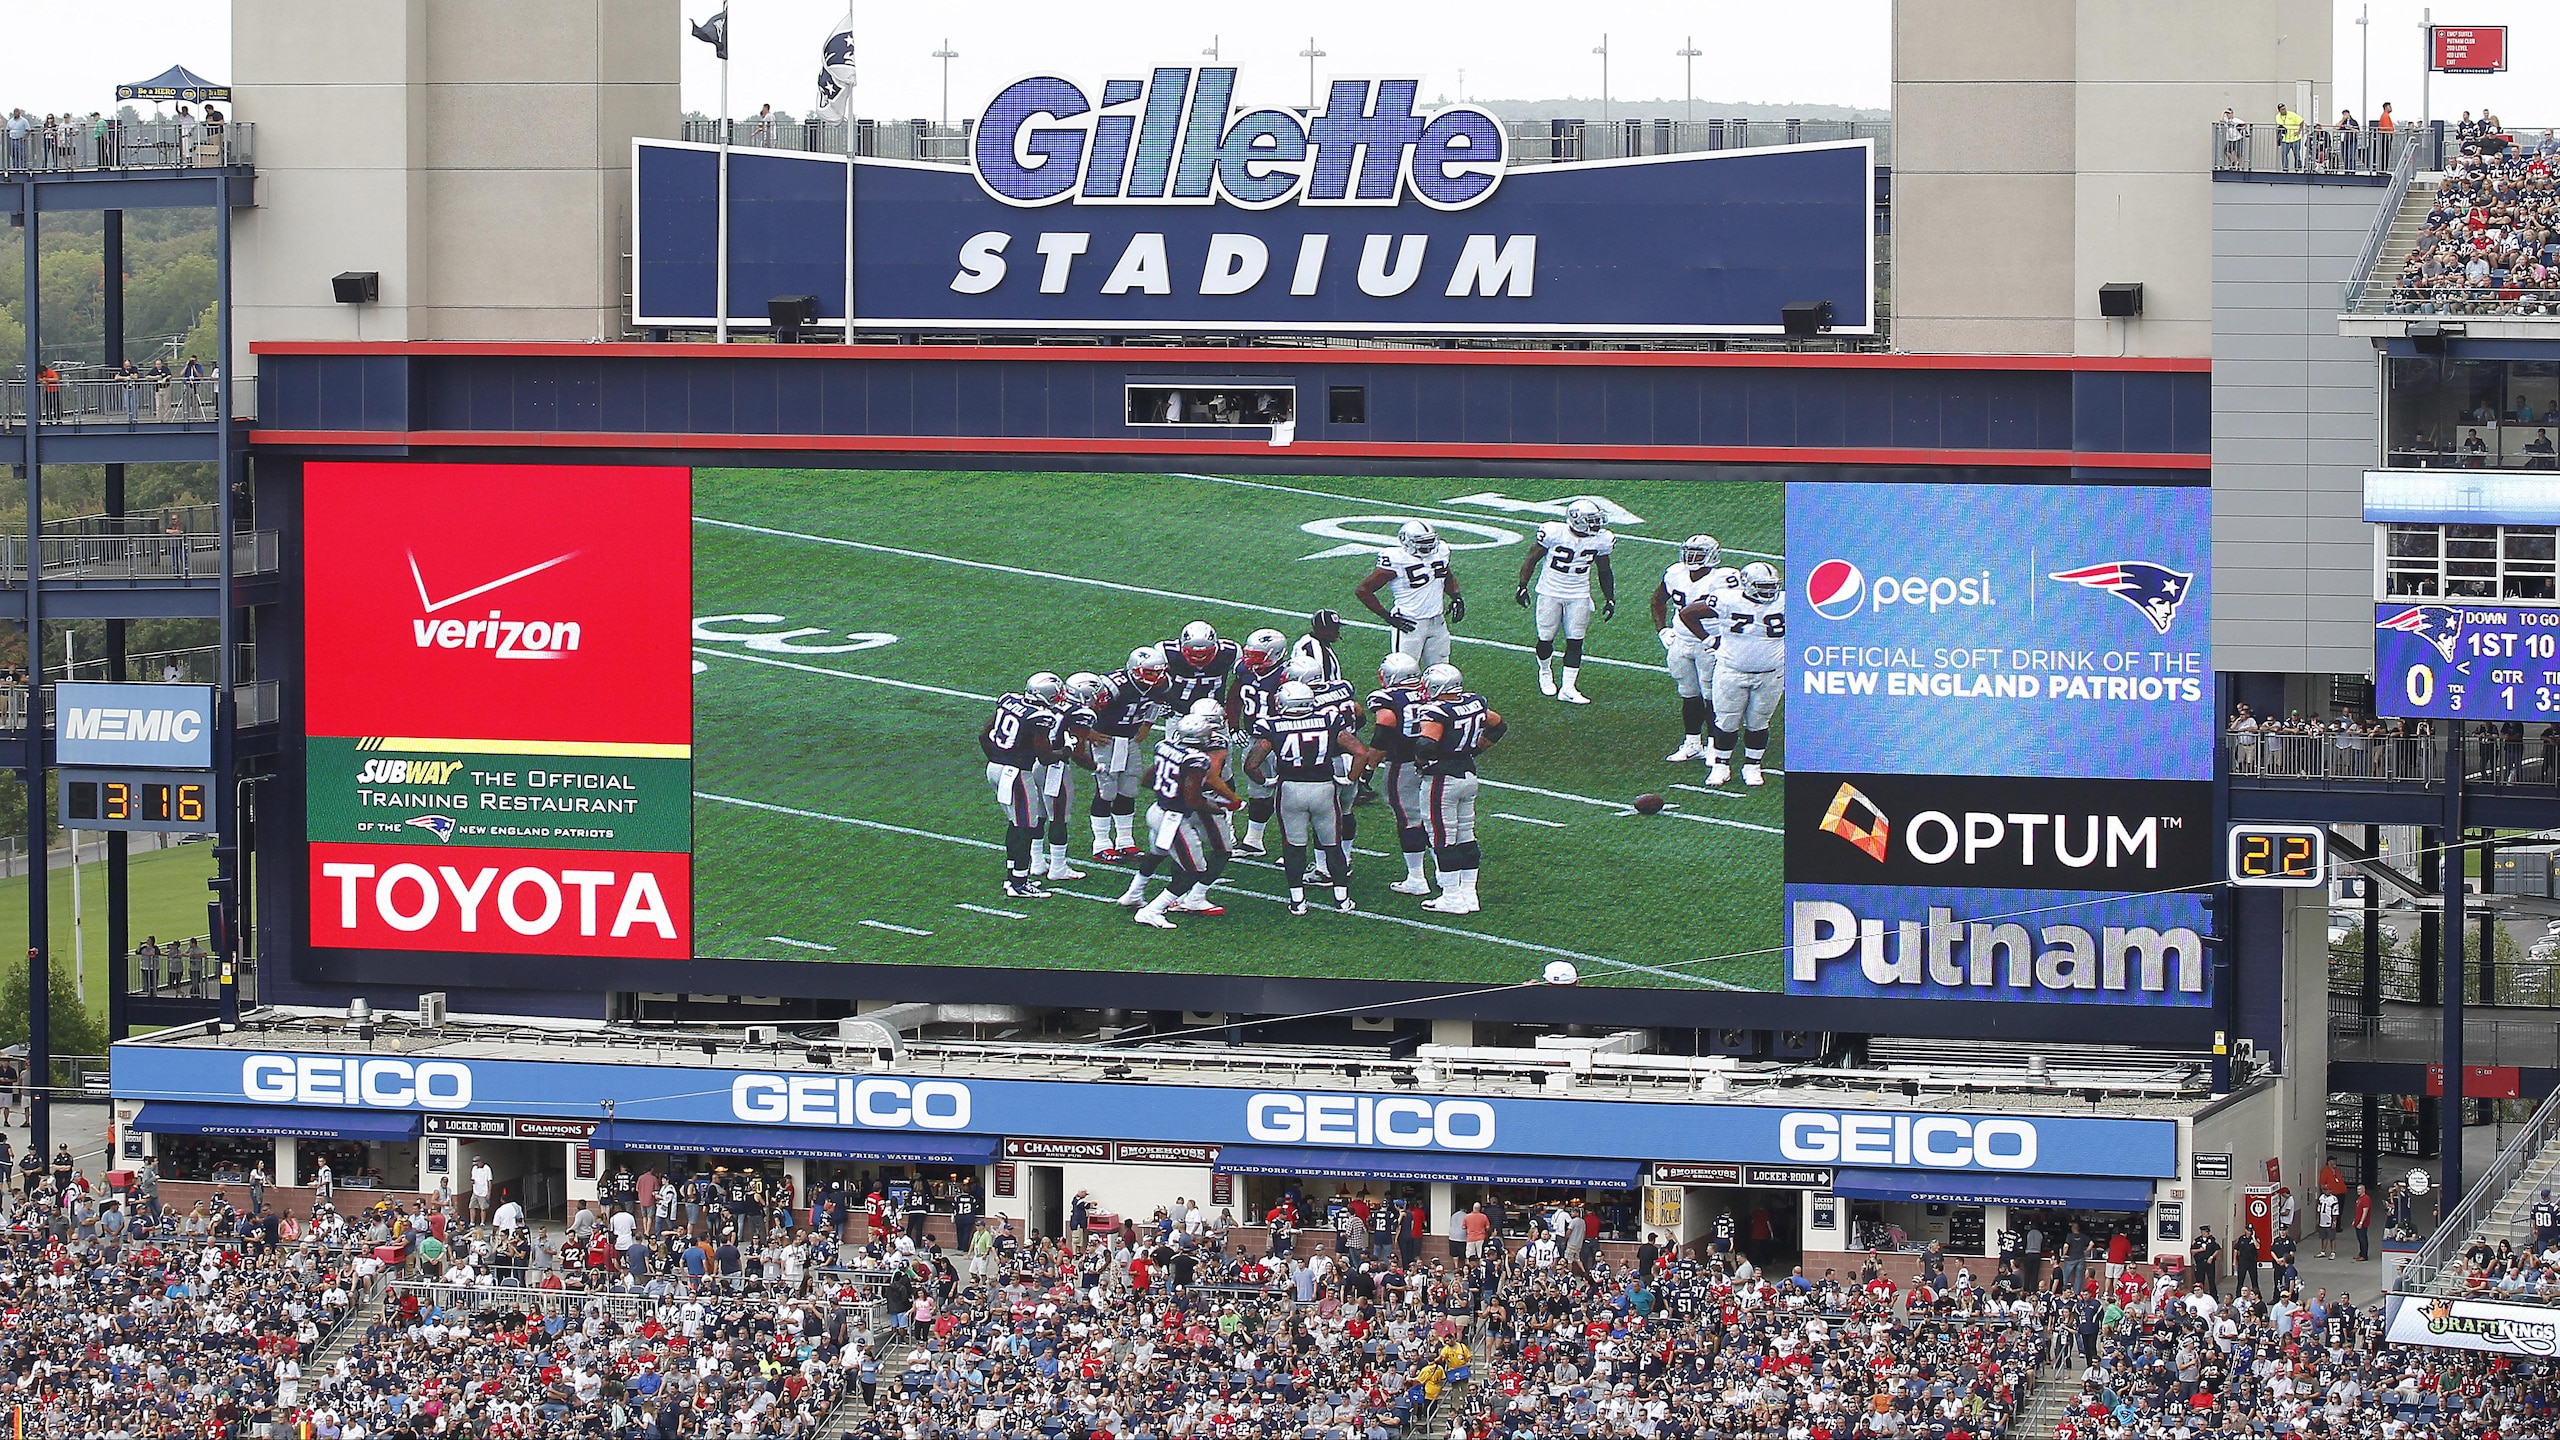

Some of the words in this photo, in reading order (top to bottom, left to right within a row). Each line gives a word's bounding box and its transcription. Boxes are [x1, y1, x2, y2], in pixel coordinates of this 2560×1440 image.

[154, 87, 176, 96] HERO
[974, 65, 1503, 205] Gillette
[949, 230, 1538, 298] STADIUM
[1550, 545, 1599, 574] 23
[1404, 560, 1449, 589] 52
[1873, 570, 1991, 614] pepsi
[1730, 612, 1785, 638] 78
[2465, 611, 2508, 625] DOWN
[2519, 612, 2538, 626] TO
[2539, 612, 2560, 627] GO
[412, 609, 581, 660] verizon
[2467, 632, 2519, 658] 1ST
[2525, 633, 2556, 659] 10
[1803, 645, 1925, 669] OFFICIAL
[1934, 647, 2003, 670] SOFT
[2012, 649, 2094, 672] DRINK
[2103, 651, 2140, 673] OF
[2149, 651, 2201, 674] THE
[2406, 662, 2434, 707] 0
[2491, 669, 2524, 685] QTR
[1174, 675, 1223, 701] 77
[1803, 670, 1884, 696] NEW
[1888, 671, 2040, 699] ENGLAND
[2049, 674, 2202, 702] PATRIOTS
[2447, 684, 2466, 694] TOL
[1240, 684, 1281, 719] 61
[2450, 694, 2462, 711] 3
[2501, 685, 2514, 711] 1
[65, 707, 202, 743] MEMIC
[988, 707, 1020, 750] 19
[1453, 712, 1487, 752] 76
[1280, 730, 1330, 767] 47
[356, 758, 464, 785] SUBWAY
[470, 770, 517, 788] THE
[357, 822, 375, 833] OF
[377, 822, 402, 834] THE
[459, 825, 488, 837] NEW
[490, 826, 550, 838] ENGLAND
[553, 827, 614, 839] PATRIOTS
[1905, 809, 2157, 869] OPTUM
[2242, 836, 2311, 876] 22
[322, 861, 678, 940] TOYOTA
[1791, 899, 2203, 993] Putnam
[242, 1054, 474, 1110] GEICO
[731, 1073, 972, 1130] GEICO
[520, 1123, 582, 1136] CHAMPIONS
[1246, 1092, 1496, 1150] GEICO
[201, 1126, 255, 1135] OFFICIAL
[256, 1128, 339, 1137] MERCHANDISE
[1023, 1142, 1104, 1156] CHAMPIONS
[1778, 1111, 2039, 1170] GEICO
[624, 1142, 672, 1151] PREMIUM
[673, 1144, 706, 1152] BEERS
[751, 1148, 795, 1157] CHICKEN
[795, 1150, 843, 1158] TENDERS
[850, 1152, 880, 1160] FRIES
[886, 1153, 921, 1161] WATER
[1120, 1145, 1206, 1160] SMOKEHOUSE
[1219, 1165, 1260, 1173] PULLED
[1261, 1166, 1289, 1174] PORK
[1294, 1168, 1321, 1176] BEEF
[1322, 1169, 1366, 1177] BRISKET
[1373, 1171, 1413, 1179] PULLED
[1413, 1173, 1459, 1181] CHICKEN
[1496, 1176, 1545, 1185] BURGERS
[1550, 1178, 1582, 1186] FRIES
[1588, 1180, 1628, 1188] SNACKS
[1670, 1168, 1737, 1180] SMOKEHOUSE
[617, 1179, 630, 1191] 75
[731, 1189, 743, 1201] 12
[911, 1195, 923, 1206] 24
[1910, 1193, 1972, 1202] OFFICIAL
[1973, 1196, 2067, 1206] MERCHANDISE
[709, 1203, 720, 1213] 12
[957, 1202, 972, 1214] 12
[1375, 1218, 1386, 1231] 12
[2160, 1214, 2180, 1222] ROOM
[2535, 1213, 2552, 1227] 80
[1716, 1224, 1729, 1238] 12
[2001, 1238, 2015, 1252] 32
[565, 1248, 579, 1261] 22
[655, 1260, 666, 1270] 87
[2124, 1282, 2139, 1294] 73
[1677, 1299, 1692, 1312] 51
[704, 1313, 718, 1326] 87
[2328, 1323, 2341, 1336] 12
[2319, 1373, 2332, 1386] 12
